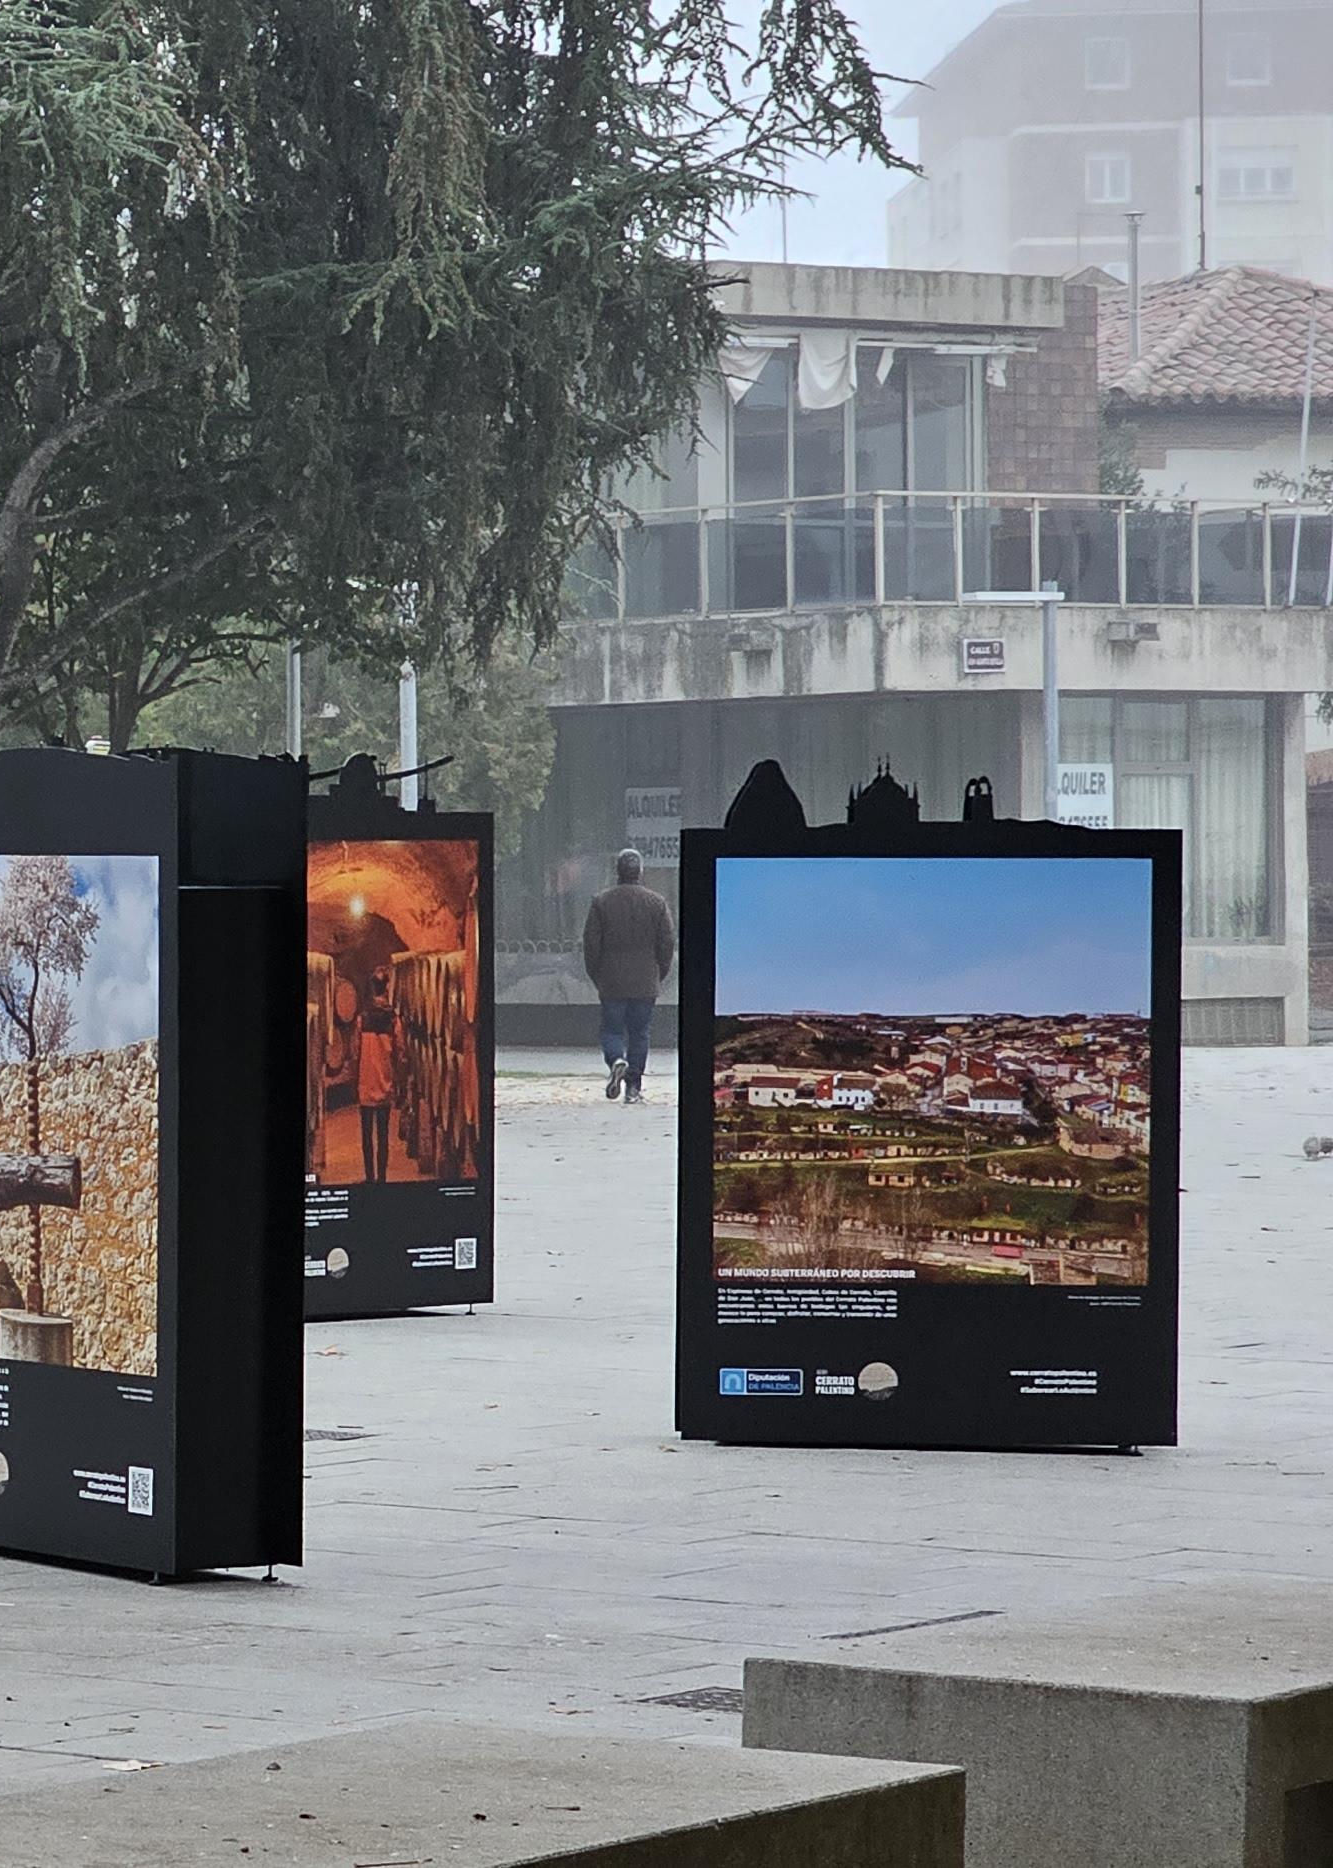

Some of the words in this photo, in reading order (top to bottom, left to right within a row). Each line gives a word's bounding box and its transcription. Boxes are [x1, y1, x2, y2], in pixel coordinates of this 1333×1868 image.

[1058, 772, 1106, 795] QUILER
[628, 794, 680, 817] ALQUILE
[718, 1268, 732, 1277] UN
[734, 1268, 769, 1277] MUNDO
[771, 1266, 839, 1278] SUBTERRÁNEO
[841, 1269, 860, 1278] POR
[862, 1269, 916, 1279] DESCUBRIR
[748, 1373, 791, 1383] Diputación
[815, 1376, 855, 1385] CERRATO
